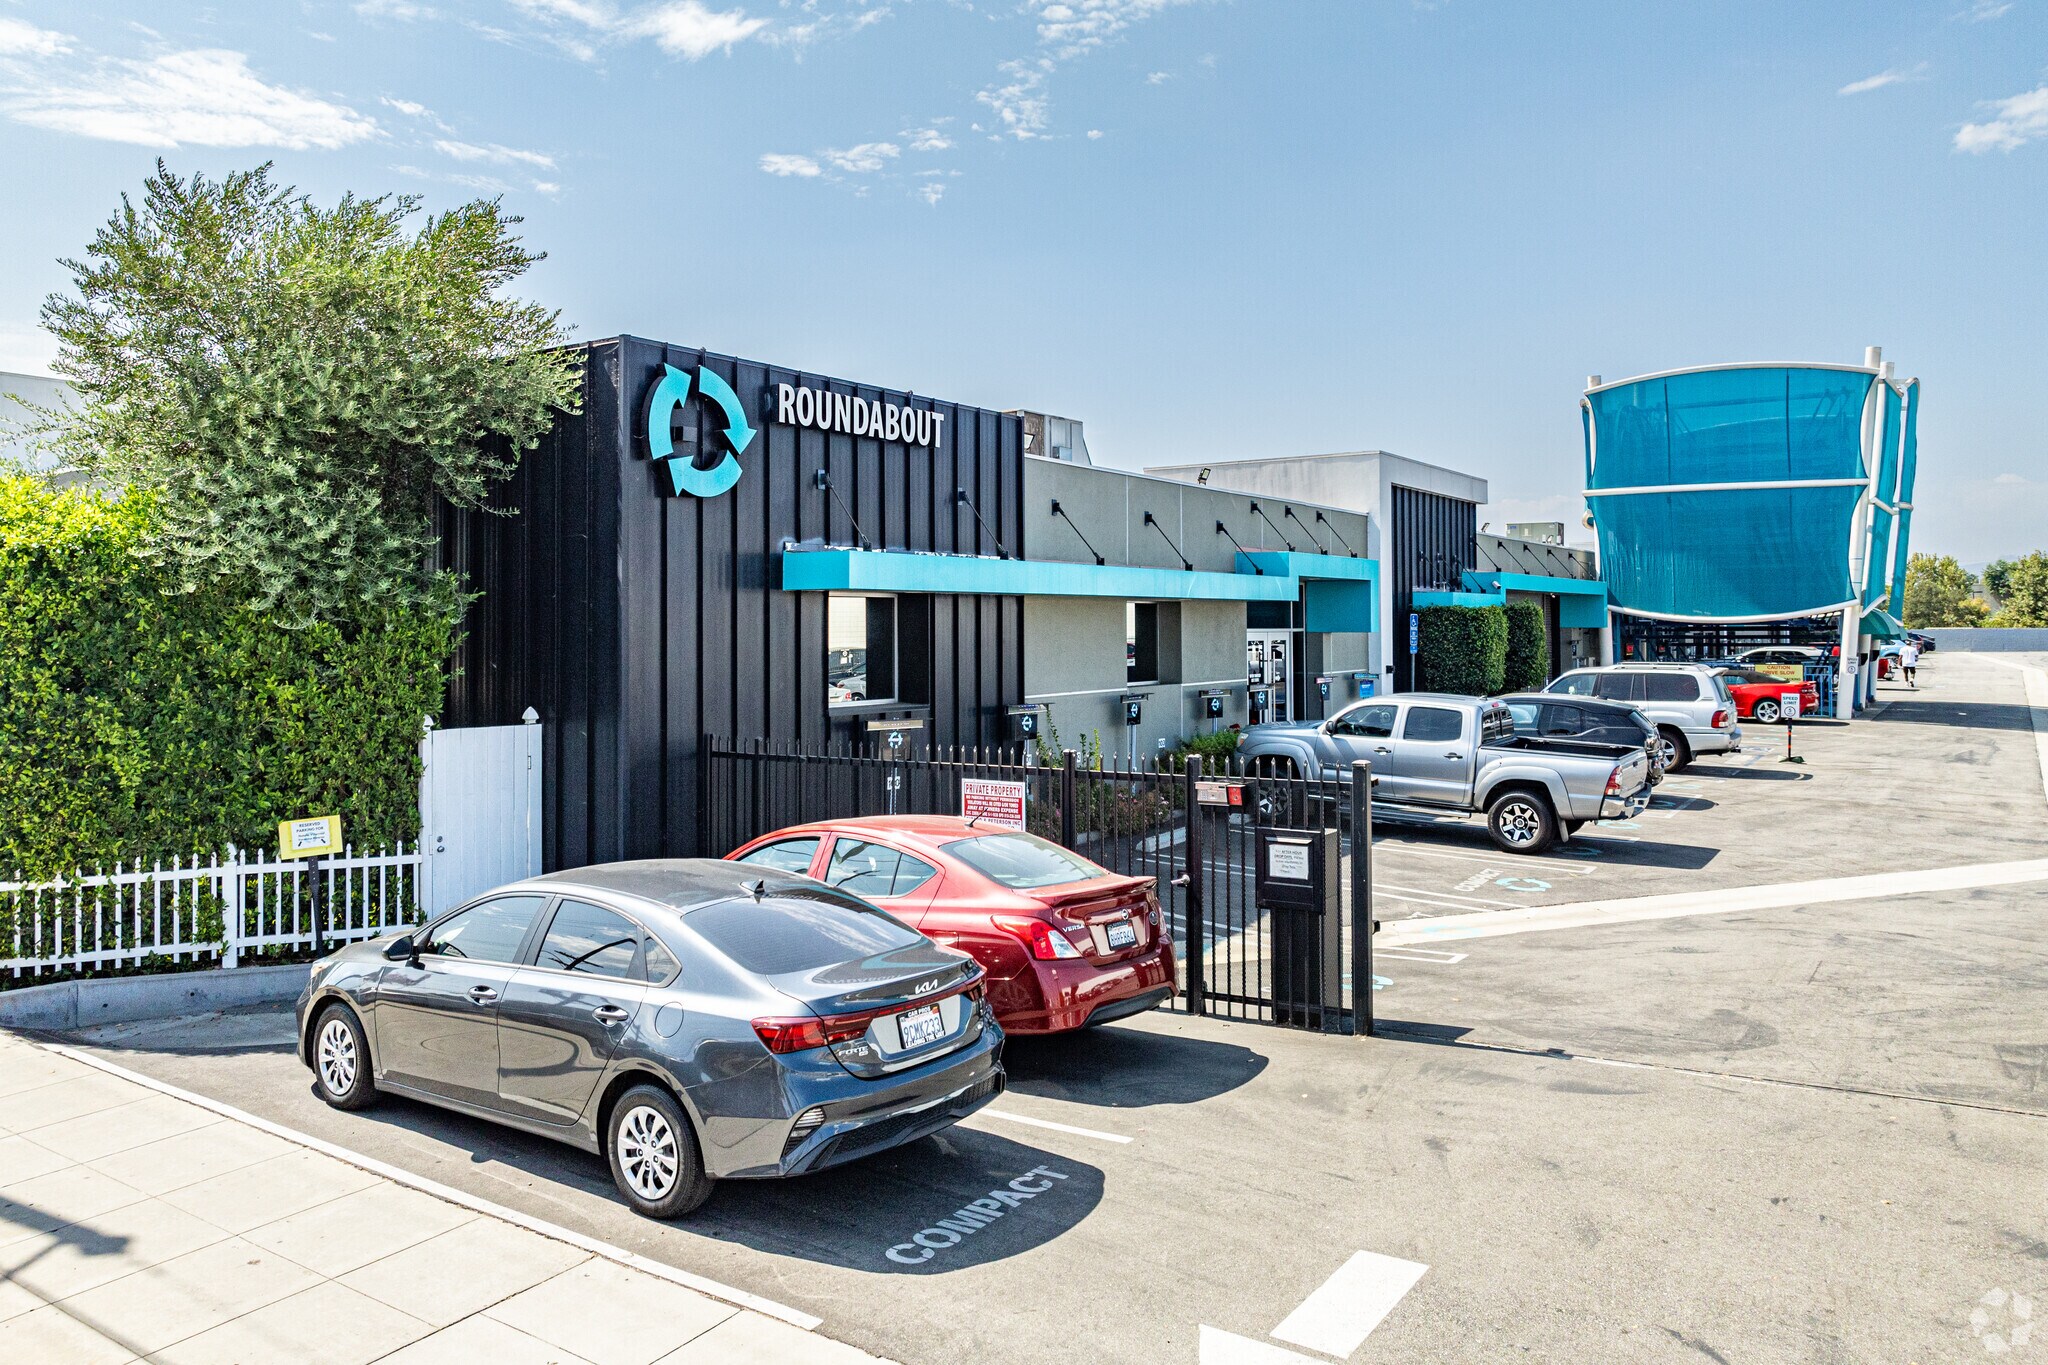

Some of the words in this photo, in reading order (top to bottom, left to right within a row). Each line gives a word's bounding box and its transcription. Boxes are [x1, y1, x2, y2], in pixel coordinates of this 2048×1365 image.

[777, 382, 945, 448] ROUNDABOUT
[966, 783, 989, 794] PRIVATE
[991, 785, 1021, 796] PROPERTY
[1453, 868, 1504, 891] COMPACT
[1062, 924, 1085, 933] VERSA
[914, 979, 938, 995] KIA
[904, 1017, 941, 1041] 9CMK233
[838, 1046, 869, 1057] FORTE
[885, 1164, 1069, 1264] COMPACT
